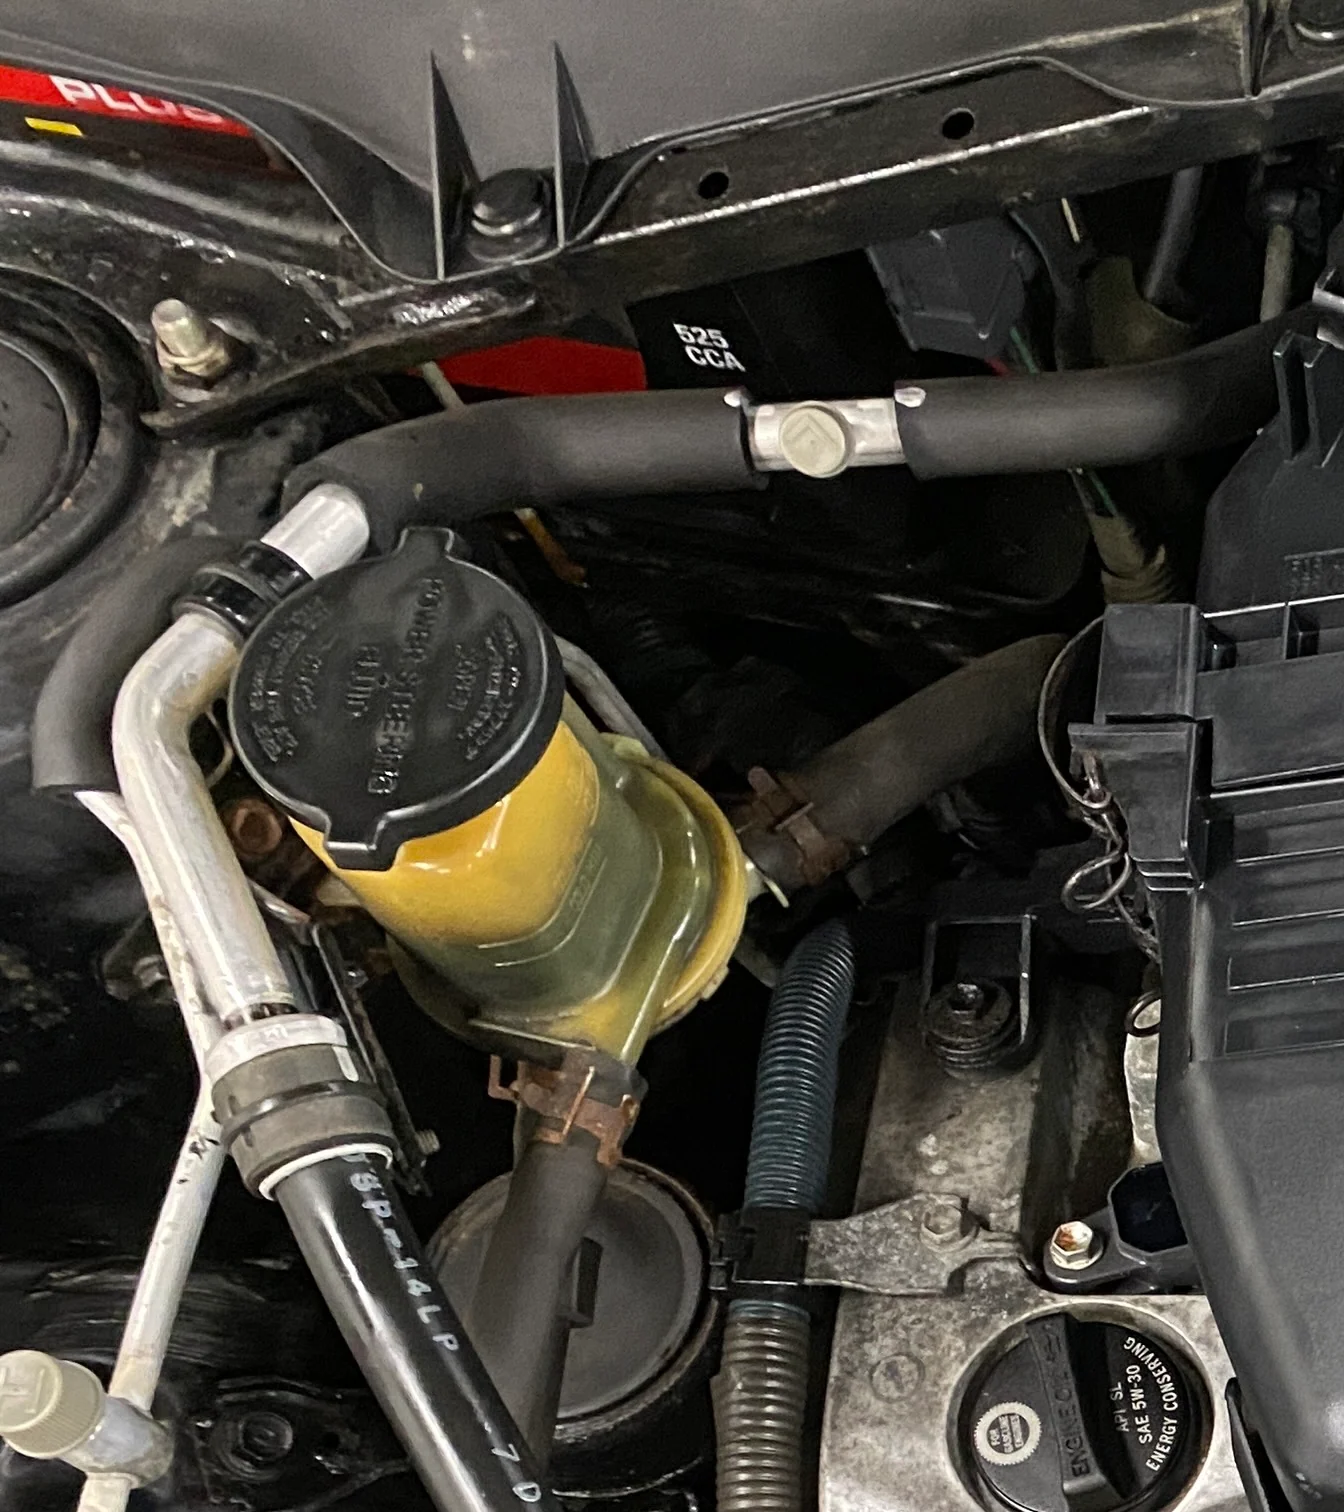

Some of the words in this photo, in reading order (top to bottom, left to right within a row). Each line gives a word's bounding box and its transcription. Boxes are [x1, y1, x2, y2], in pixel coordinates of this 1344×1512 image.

[673, 322, 729, 349] 525
[684, 345, 746, 372] CCA
[1123, 1336, 1179, 1412] CONSERVING
[1125, 1363, 1147, 1411] 5W-30
[1110, 1381, 1124, 1401] SL
[1113, 1408, 1130, 1433] API
[1134, 1414, 1153, 1445] SAE
[1058, 1404, 1091, 1478] ENGINE
[1145, 1416, 1179, 1472] ENERGY
